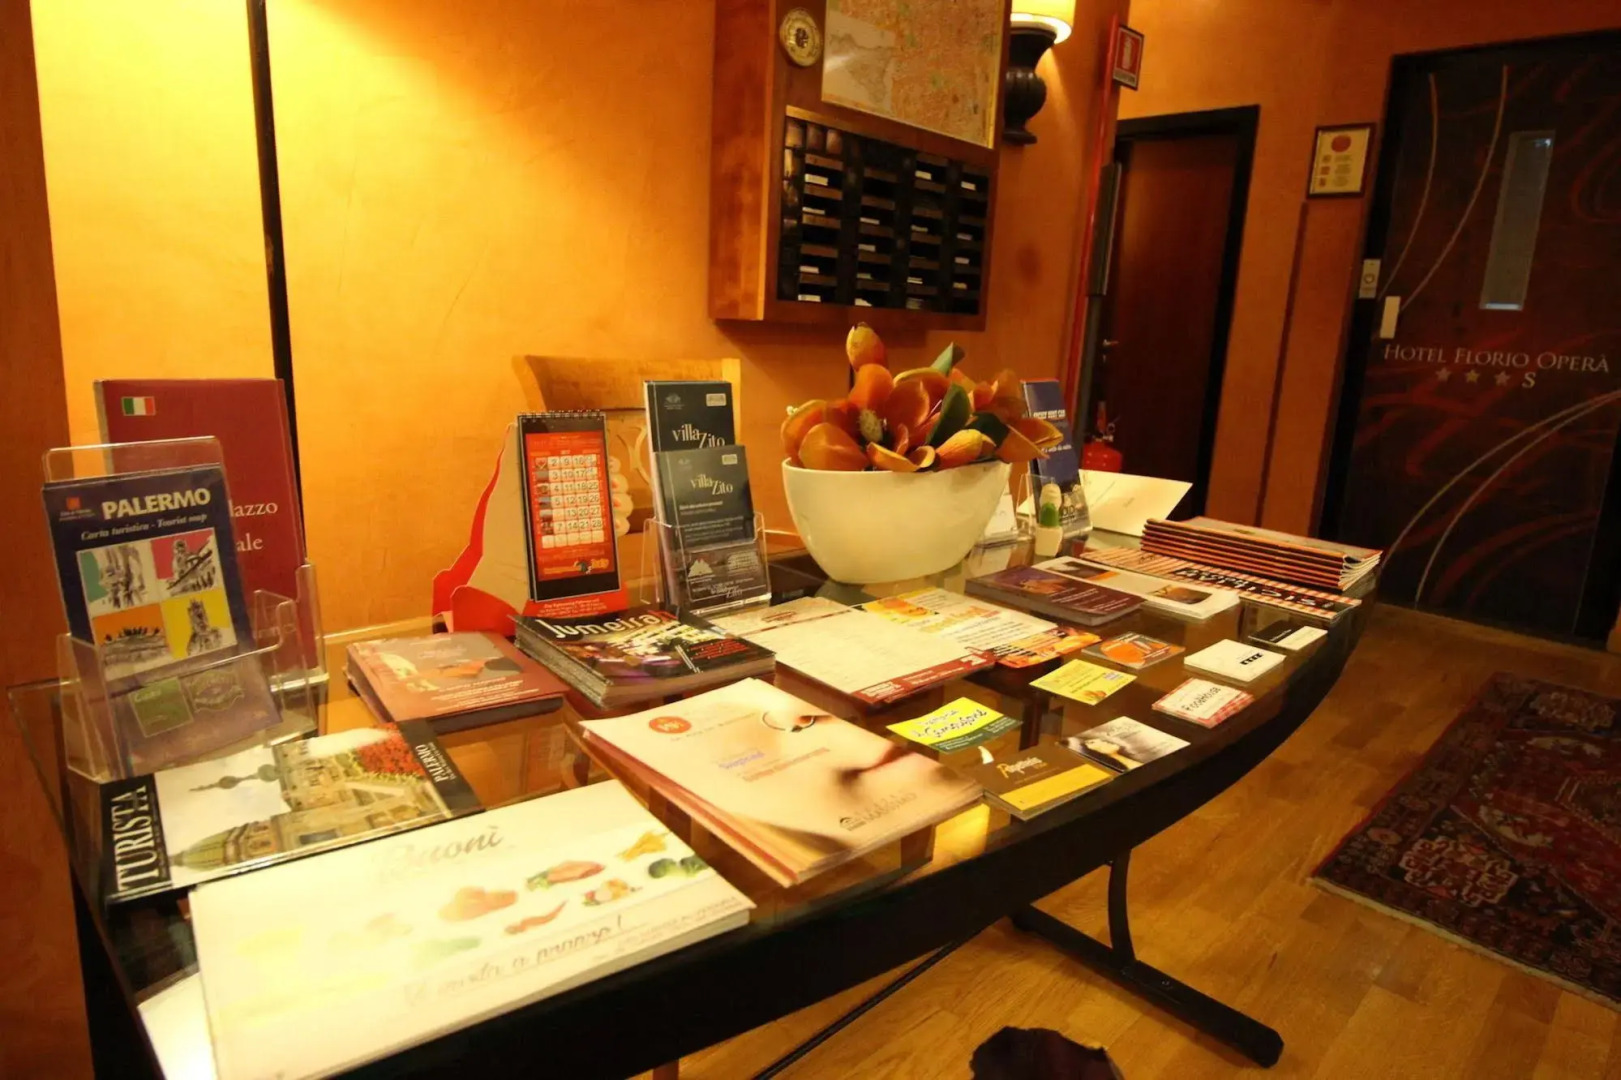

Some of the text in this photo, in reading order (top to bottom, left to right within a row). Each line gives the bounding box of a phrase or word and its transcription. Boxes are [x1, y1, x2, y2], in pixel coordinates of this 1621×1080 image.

[1384, 344, 1447, 363] HOTEL
[1454, 347, 1530, 369] FLORIO
[1521, 371, 1536, 388] S
[672, 423, 726, 449] villa Zito
[690, 473, 734, 496] villa Zito
[102, 488, 211, 520] PALERMO
[157, 516, 187, 528] Tourist
[415, 744, 449, 783] PALERMO
[111, 785, 160, 892] TURISTA
